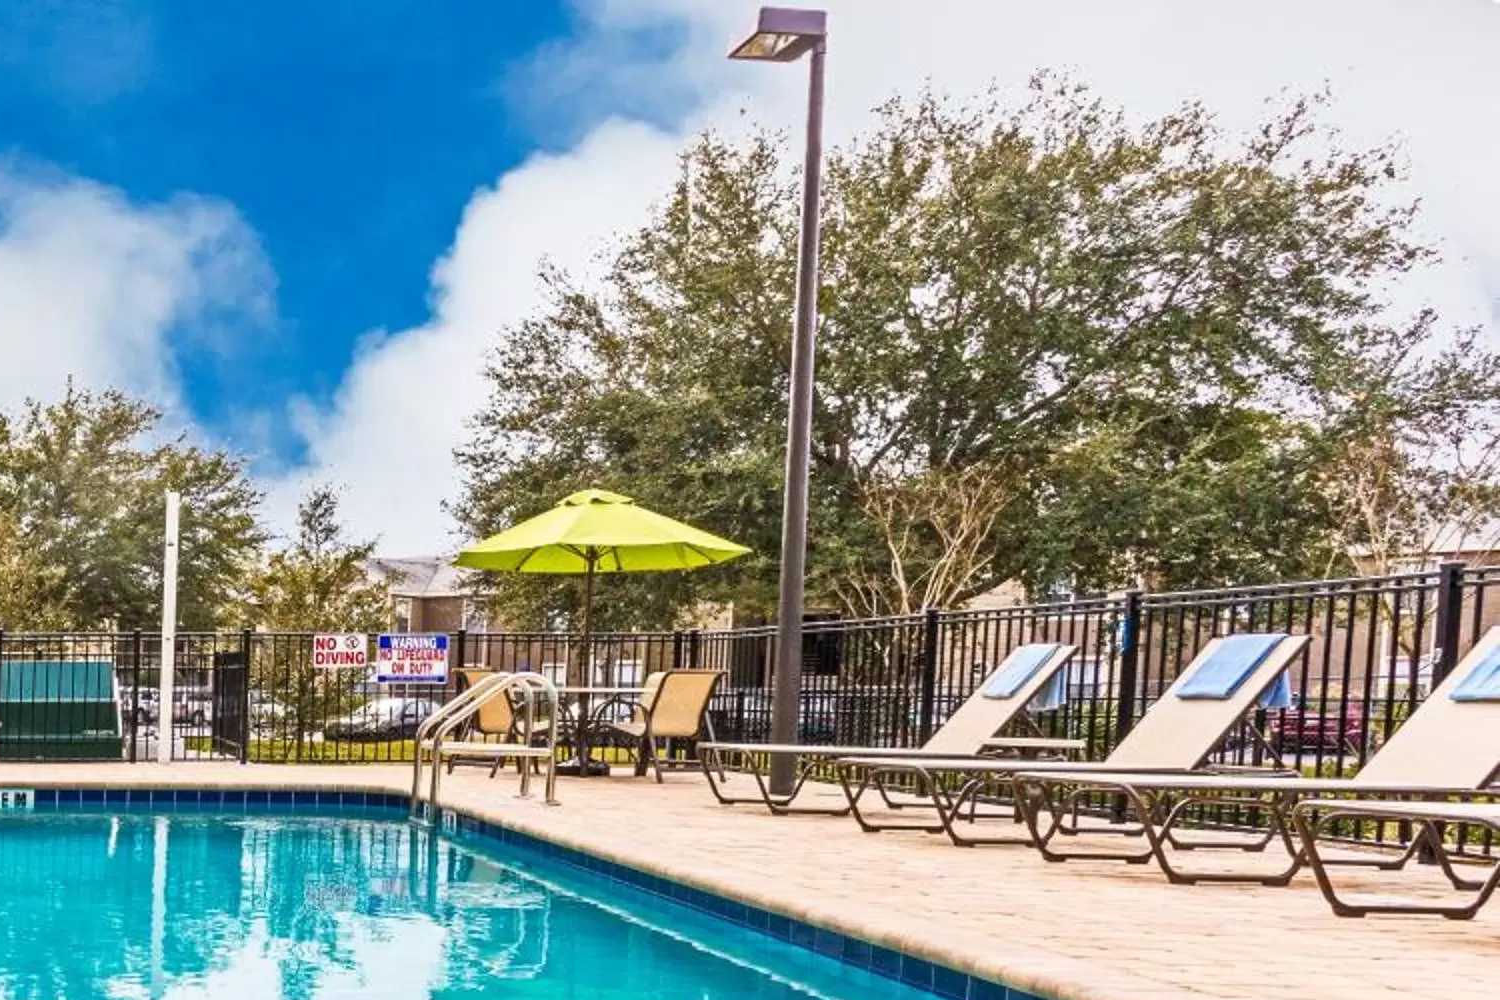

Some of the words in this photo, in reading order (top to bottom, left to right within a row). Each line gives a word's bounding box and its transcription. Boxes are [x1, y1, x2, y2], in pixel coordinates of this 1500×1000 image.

[315, 637, 337, 650] NO
[389, 637, 437, 649] WARNING
[315, 652, 365, 665] DIVING
[379, 649, 392, 660] NO
[397, 649, 444, 661] LIFEGUARD
[392, 662, 404, 673] ON
[410, 662, 433, 673] DUTY
